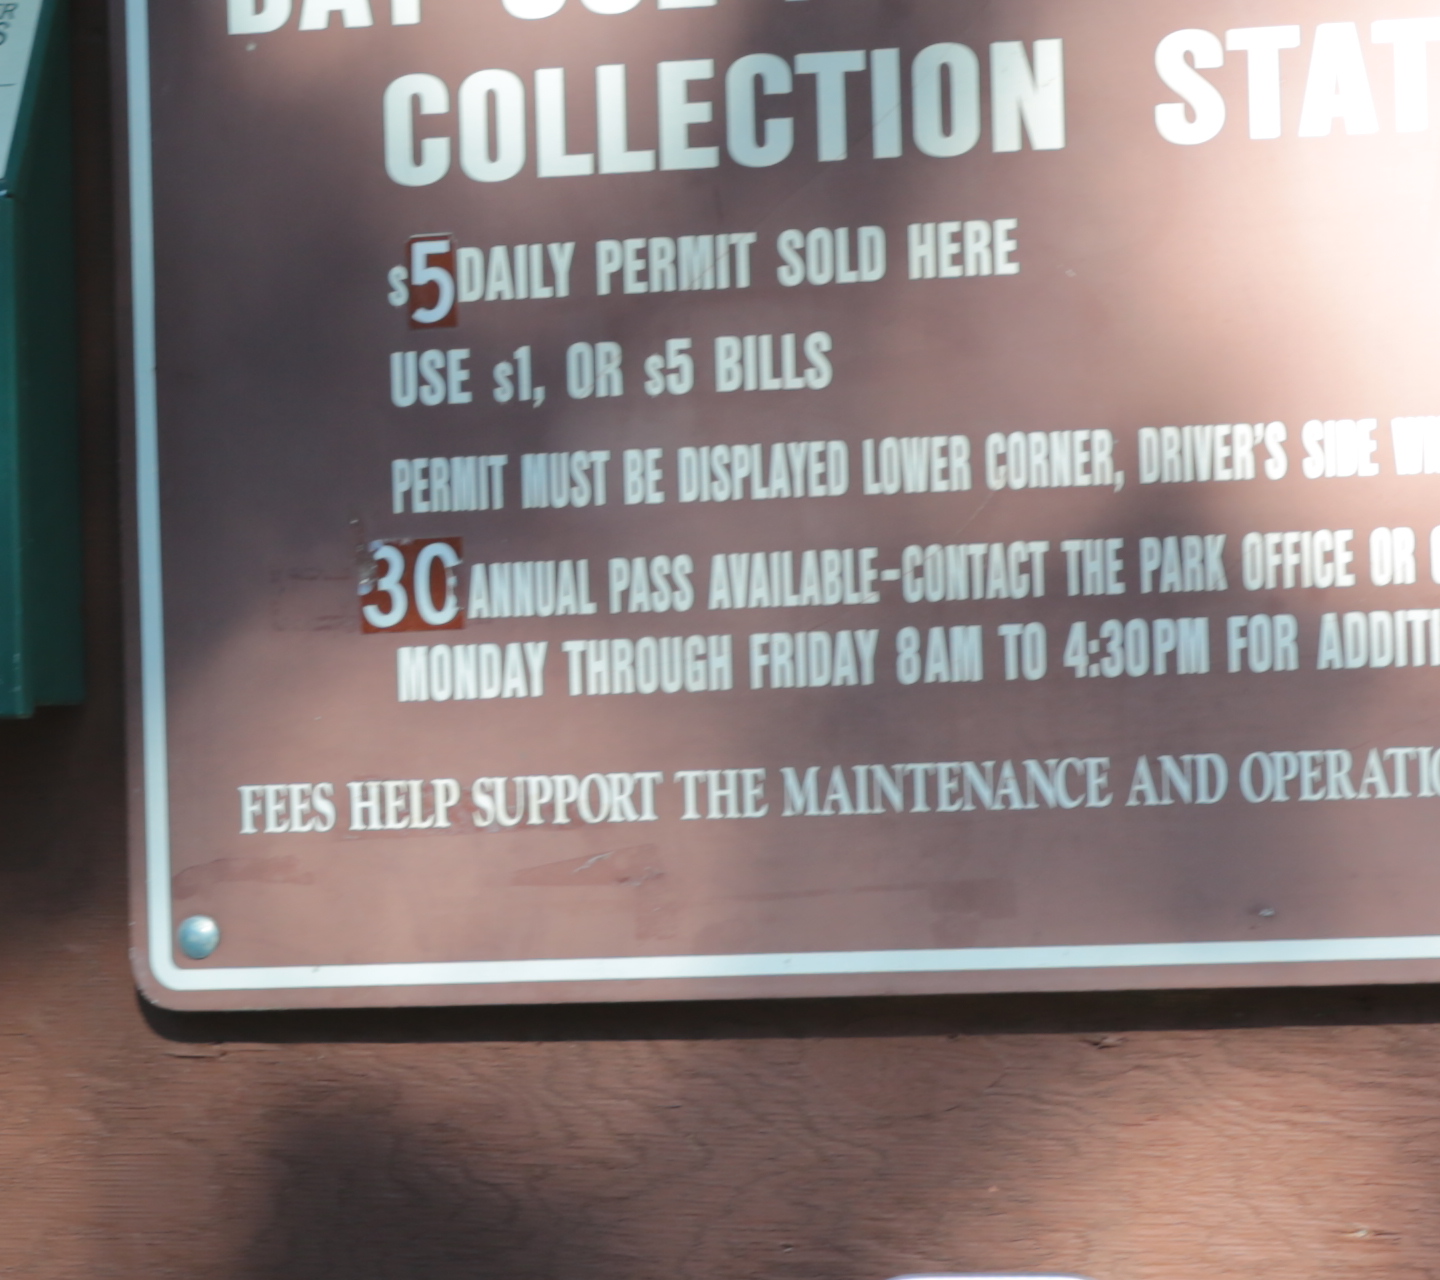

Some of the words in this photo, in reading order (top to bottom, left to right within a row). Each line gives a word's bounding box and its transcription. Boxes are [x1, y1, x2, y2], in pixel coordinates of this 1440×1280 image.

[383, 38, 1065, 187] COLLECTION
[596, 233, 757, 296] PERMIT
[777, 225, 886, 289] SOLD
[908, 219, 1020, 280] HERE
[391, 349, 472, 408] USE
[566, 341, 623, 400] OR
[644, 337, 695, 397] $5
[715, 331, 833, 393] BILLS
[391, 454, 508, 514] PERMIT
[521, 450, 610, 509] MUST
[623, 447, 665, 505] BE
[677, 440, 849, 504] DISPLAYED
[862, 434, 971, 495] LOWER
[985, 427, 1124, 492] CORNER,
[1138, 421, 1287, 485] DRIVER'S
[1302, 417, 1379, 480] SIDE
[468, 559, 597, 620] ANNUAL
[608, 554, 694, 614] PASS
[1061, 538, 1125, 597] THE
[1139, 534, 1229, 594] PARK
[1243, 529, 1354, 590] OFFICE
[1370, 526, 1417, 587] OR
[397, 641, 548, 703] MONDAY
[562, 633, 733, 697] THROUGH
[749, 630, 879, 690] FRIDAY
[999, 621, 1047, 681] TO
[1063, 617, 1210, 678] 4:30PM
[1227, 614, 1299, 673] FOR
[238, 783, 336, 835] FEES
[348, 777, 460, 831] HELP
[472, 772, 663, 829] SUPPORT
[674, 767, 768, 821] THE
[781, 756, 1113, 818] MAINTENANCE
[1125, 753, 1229, 808] AND
